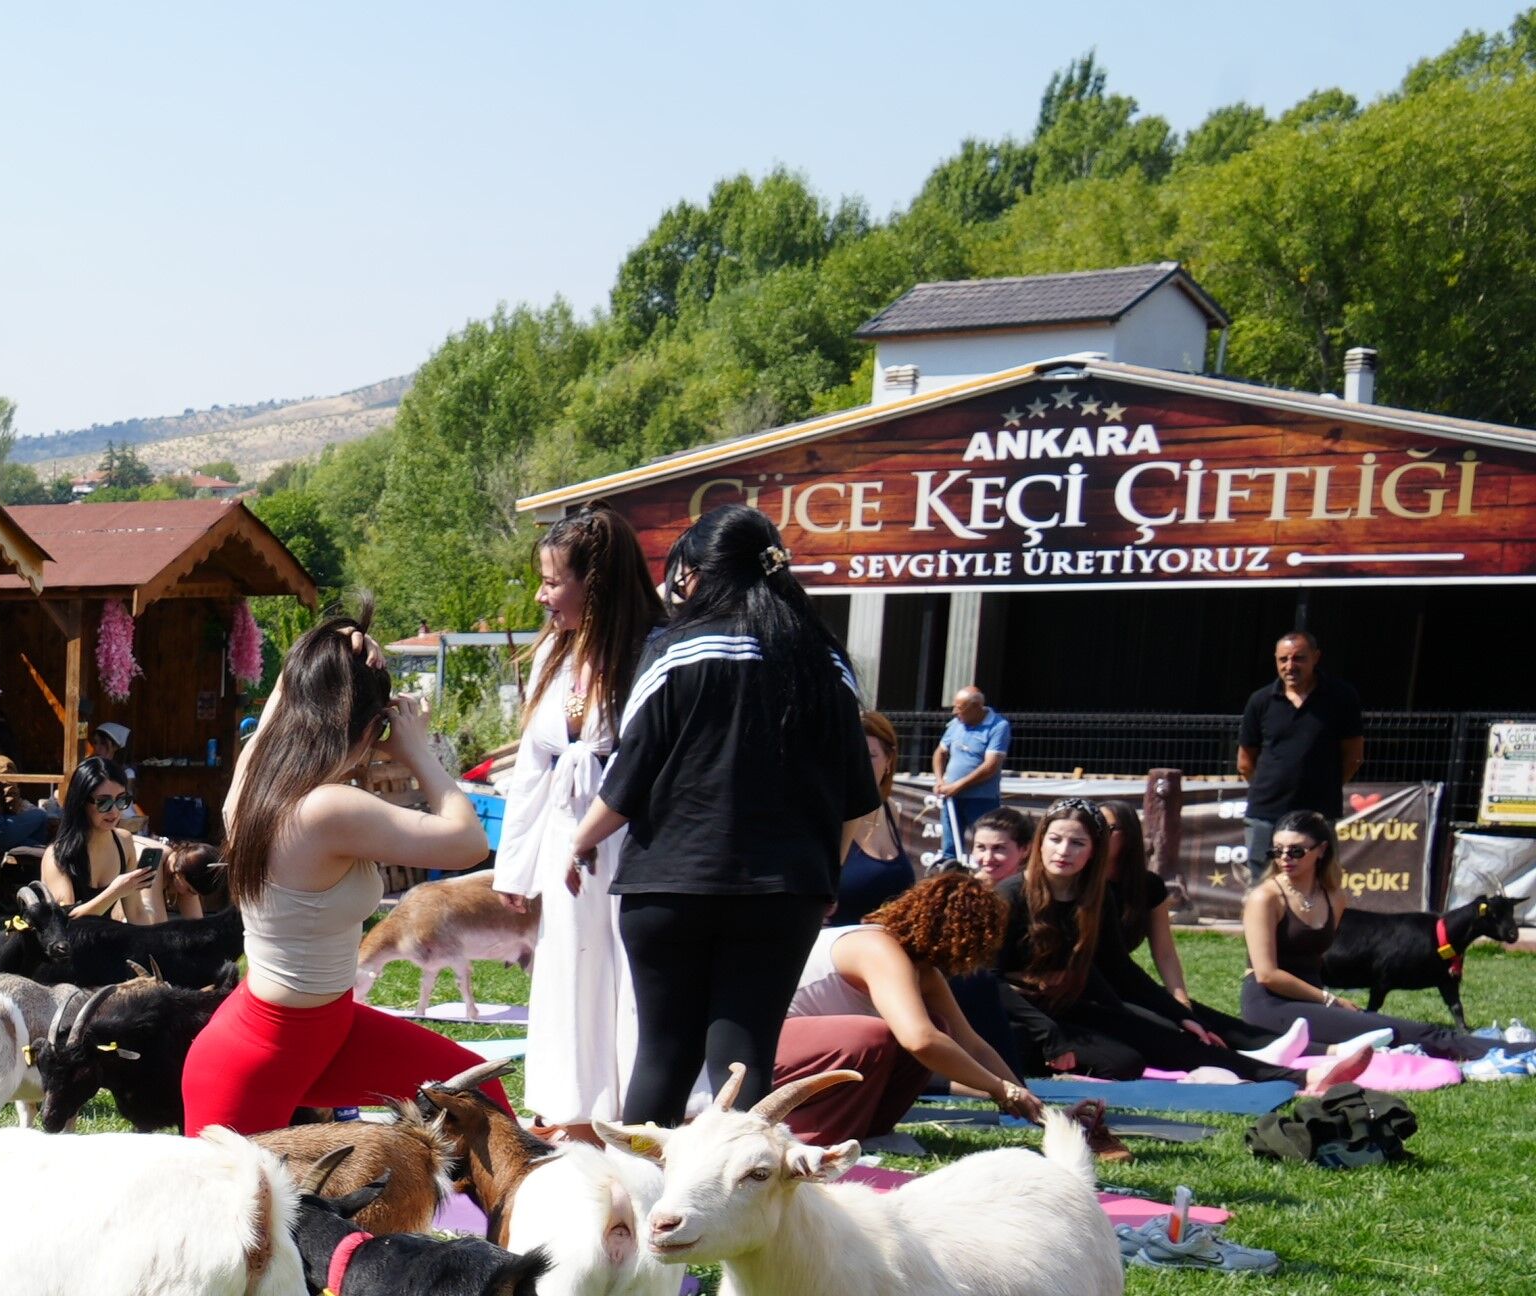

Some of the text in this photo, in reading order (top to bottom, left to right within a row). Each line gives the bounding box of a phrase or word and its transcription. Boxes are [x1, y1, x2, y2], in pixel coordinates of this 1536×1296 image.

[962, 424, 1161, 462] ANKARA
[909, 462, 1089, 548] KEÇİ
[1114, 447, 1483, 545] ÇİFTLİĞİ
[848, 545, 1271, 579] SEVGİYLE ÜRETİYORUZ
